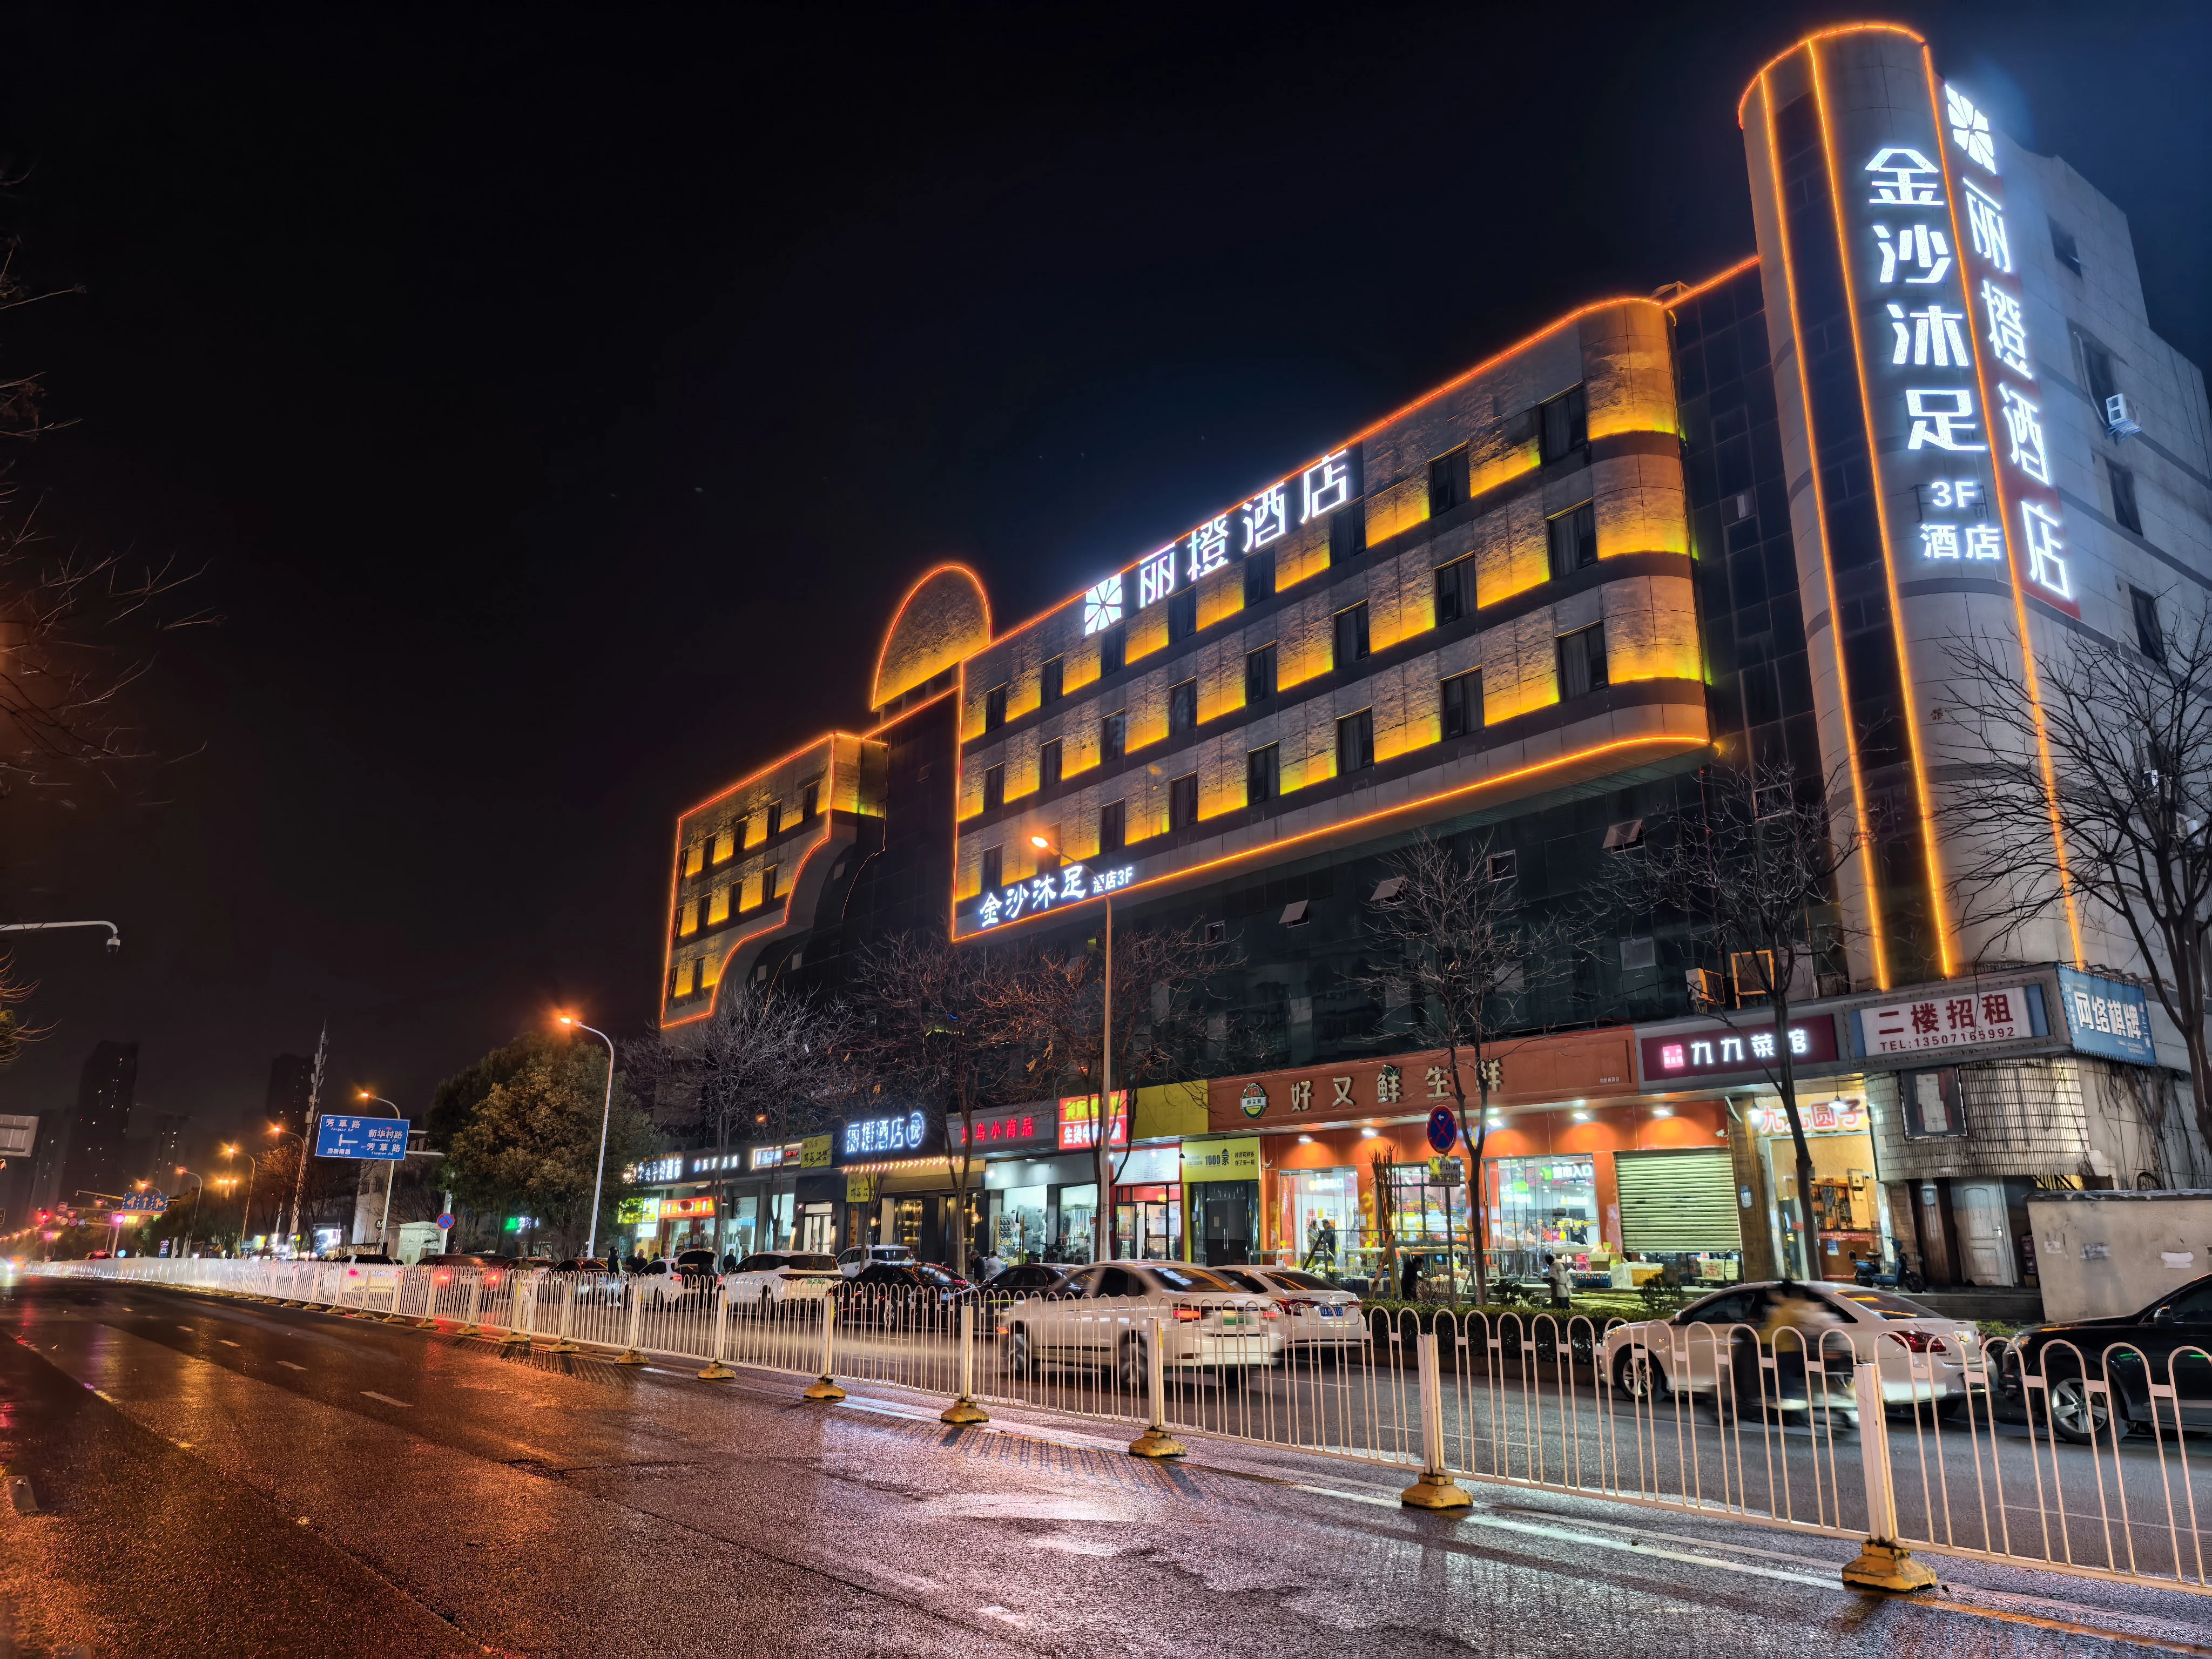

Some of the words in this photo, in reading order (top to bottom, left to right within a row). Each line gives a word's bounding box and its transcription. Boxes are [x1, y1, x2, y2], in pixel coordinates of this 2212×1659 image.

[1865, 147, 1988, 453] 金沙沐足
[1962, 176, 2072, 599] 丽橙酒店
[1931, 481, 1976, 509] 3F
[1139, 449, 1348, 610] 丽橙酒店
[1919, 522, 2001, 561] 酒店
[980, 865, 1087, 927] 金沙沐足
[1879, 994, 2014, 1035] 二楼招租
